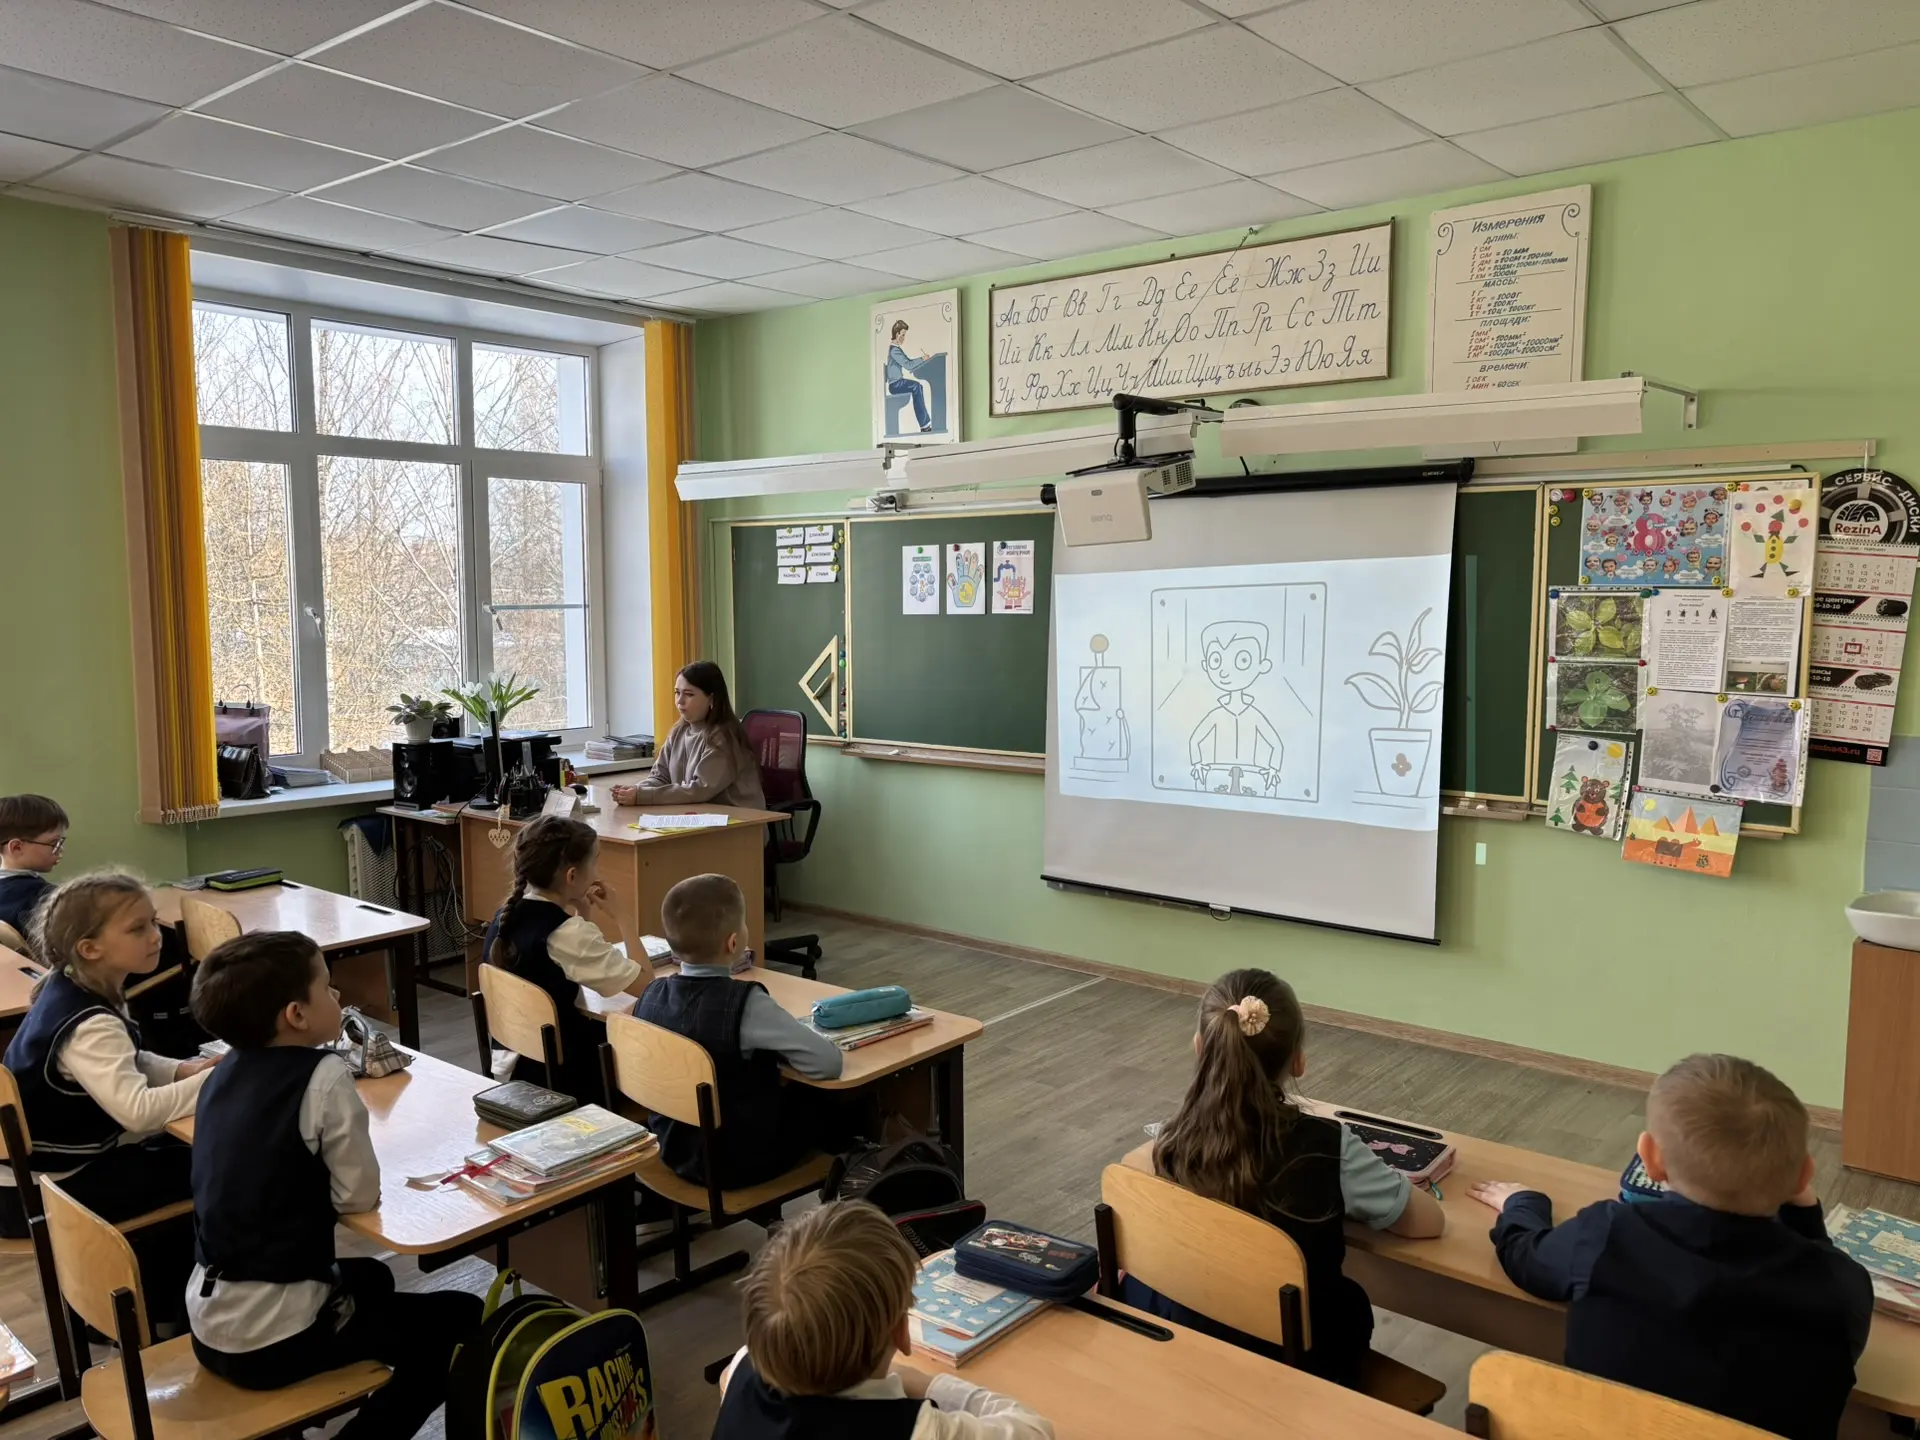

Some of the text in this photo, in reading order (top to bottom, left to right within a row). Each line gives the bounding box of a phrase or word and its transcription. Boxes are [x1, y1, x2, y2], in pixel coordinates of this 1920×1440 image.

[1472, 214, 1545, 233] Измерения
[996, 243, 1381, 327] Аа Бб Вв Гг Дд Ее Ёё Жж Зз Ии
[1483, 277, 1520, 288] МАССЫ:
[999, 289, 1381, 365] Йй Кк Лл Мм Нн Оо Пп Рр Сс Тт
[1480, 316, 1531, 327] ПЛОЩАДИ:
[995, 377, 1015, 413] Уу
[1022, 373, 1049, 409] Фф
[1051, 369, 1081, 397] Хх
[1087, 365, 1113, 399] Цц
[1116, 363, 1143, 391] Чч
[1146, 358, 1182, 387] Шш
[1186, 353, 1221, 387] Щщ
[1264, 345, 1290, 375] Ээ
[1296, 339, 1334, 371] Юю
[1337, 335, 1372, 367] Яя
[1835, 472, 1892, 486] СЕРВИС
[1633, 513, 1667, 553] 8
[1834, 523, 1881, 535] RezinA
[536, 1352, 634, 1440] RACING
